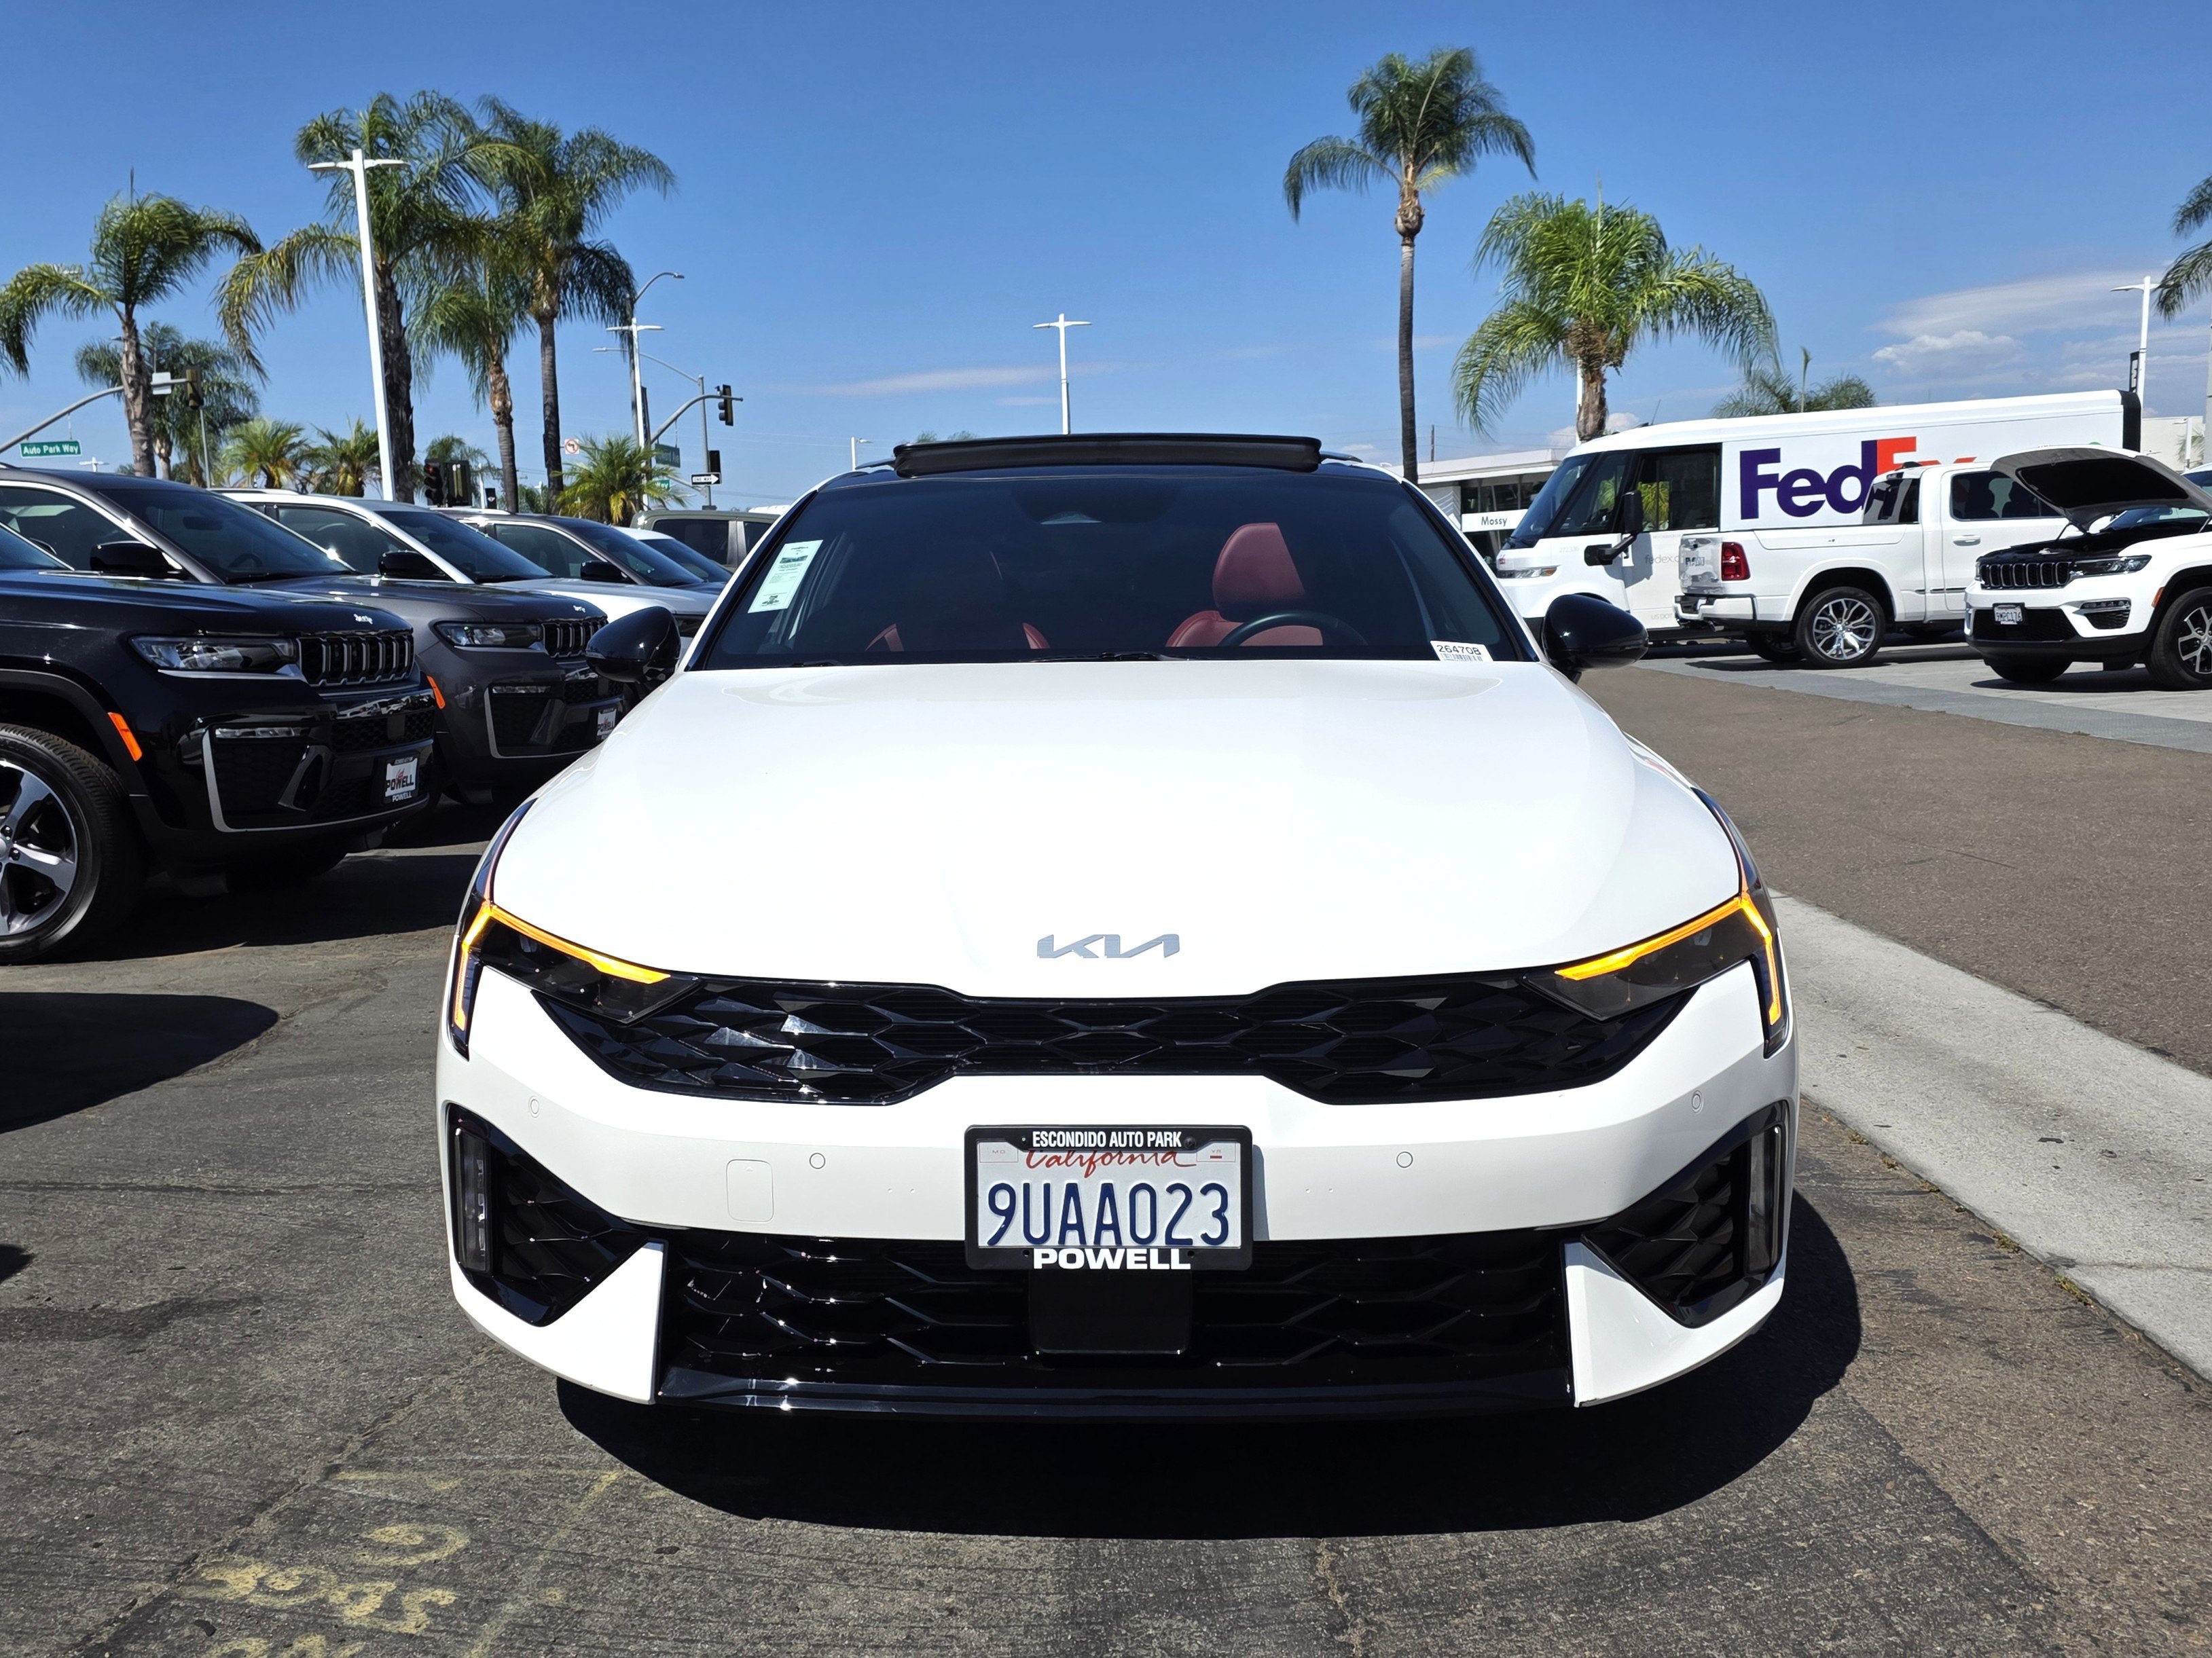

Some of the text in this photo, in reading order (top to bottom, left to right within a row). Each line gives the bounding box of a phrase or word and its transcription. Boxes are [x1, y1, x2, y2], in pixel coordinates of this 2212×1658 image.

[23, 443, 79, 454] Auto Park Way
[1481, 516, 1507, 527] Mossy
[385, 774, 414, 792] POWELL
[392, 791, 412, 803] POWELL
[1036, 934, 1180, 959] KIA
[1032, 1131, 1182, 1147] ESCONDIDO AUTO PARK
[1026, 1149, 1197, 1178] California
[987, 1183, 1229, 1245] 9UAA023
[1034, 1248, 1191, 1270] POWELL
